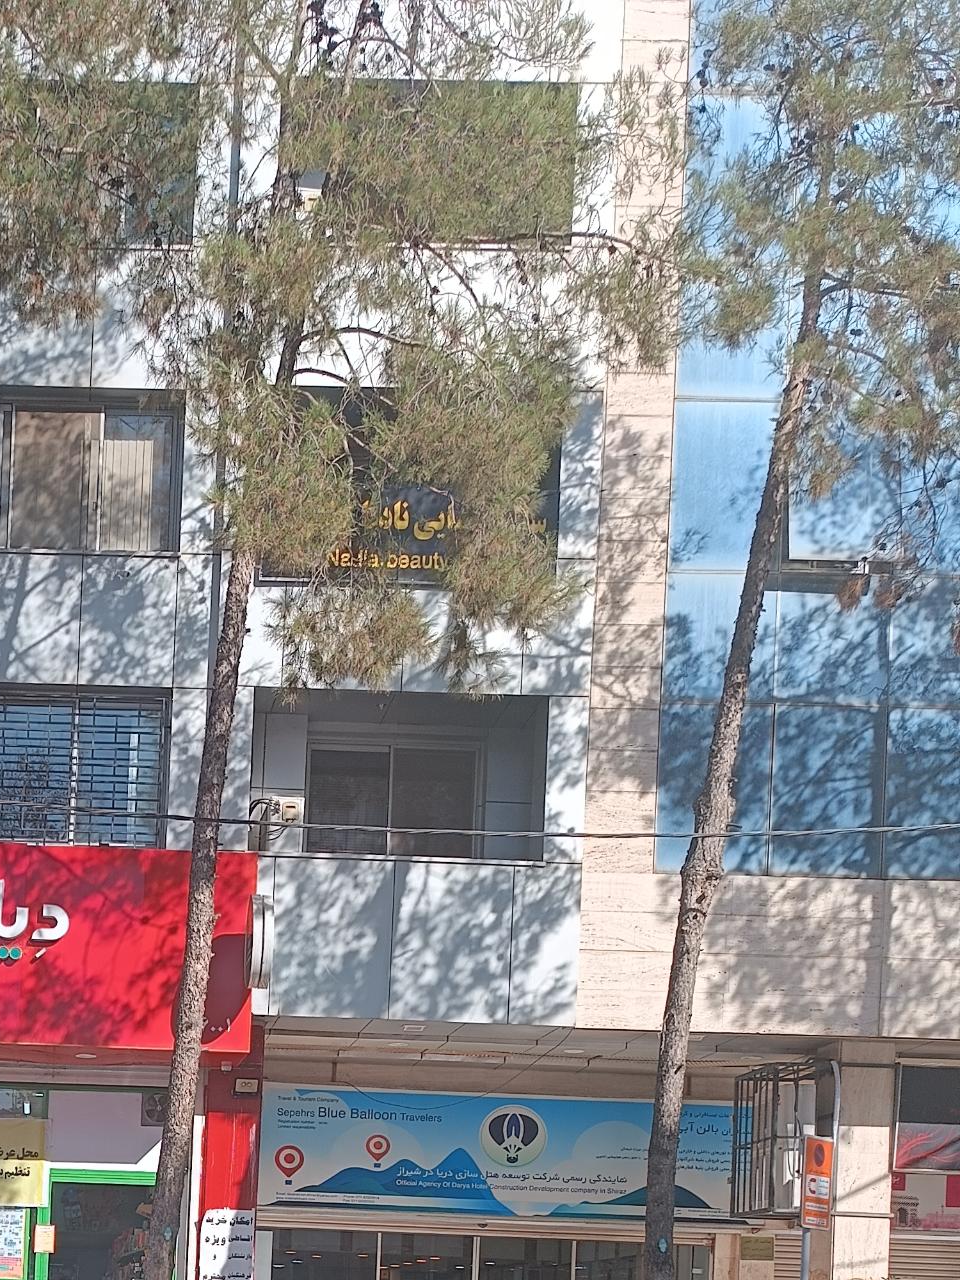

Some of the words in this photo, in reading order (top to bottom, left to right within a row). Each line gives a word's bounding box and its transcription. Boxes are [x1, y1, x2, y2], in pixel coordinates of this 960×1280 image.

[318, 1106, 346, 1119] Blue
[350, 1108, 397, 1121] Balloon
[399, 1112, 442, 1123] Travelers
[696, 1123, 719, 1135] بالن
[17, 1150, 39, 1161] محل
[4, 1166, 31, 1178] تنظیم
[396, 1166, 421, 1178] شیراز
[423, 1167, 434, 1177] در
[436, 1168, 453, 1178] دریا
[455, 1169, 478, 1180] سازی
[481, 1170, 499, 1180] هتل
[501, 1171, 530, 1182] توسعه
[532, 1172, 560, 1183] شرکت
[562, 1175, 587, 1184] رسمی
[589, 1174, 627, 1185] نمایندگی
[418, 1180, 441, 1189] Agency
[451, 1182, 470, 1190] Darya
[528, 1185, 569, 1193] Development
[570, 1187, 598, 1195] company
[607, 1187, 627, 1195] Shiraz
[206, 1215, 227, 1225] خرید
[230, 1216, 253, 1226] امکان
[204, 1235, 226, 1246] ویژه
[202, 1272, 226, 1280] محترم
